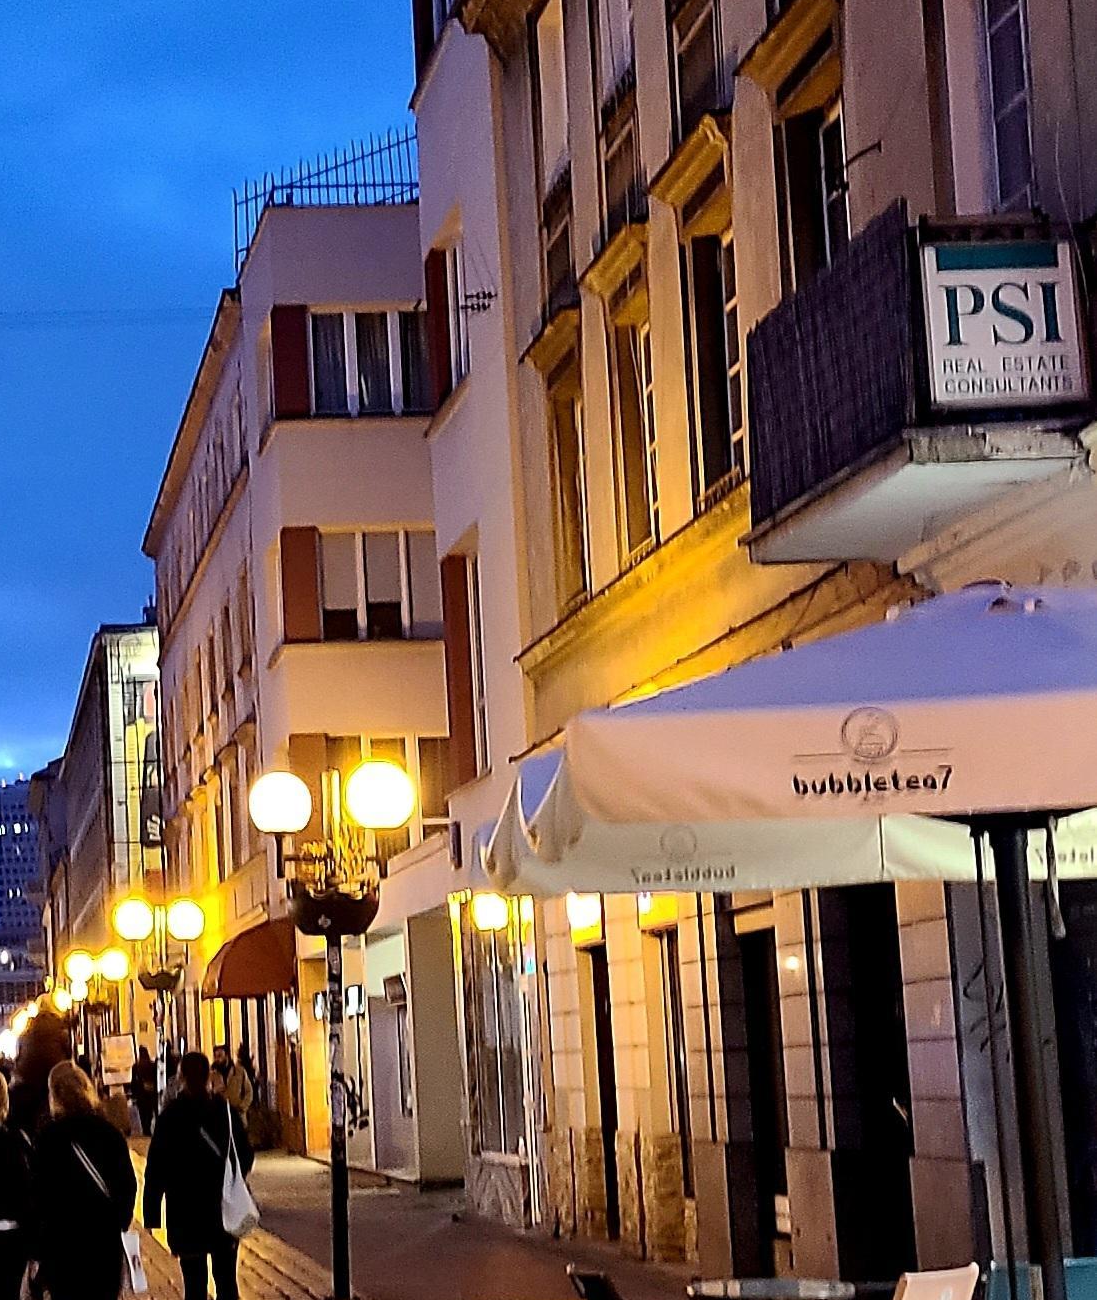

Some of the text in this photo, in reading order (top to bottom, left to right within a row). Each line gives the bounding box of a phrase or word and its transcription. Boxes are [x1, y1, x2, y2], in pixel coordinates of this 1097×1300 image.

[938, 280, 1065, 347] PSI
[941, 353, 1070, 374] REAL ESTATE
[944, 375, 1074, 395] CONSULTANTS
[792, 764, 953, 795] bubbletea7
